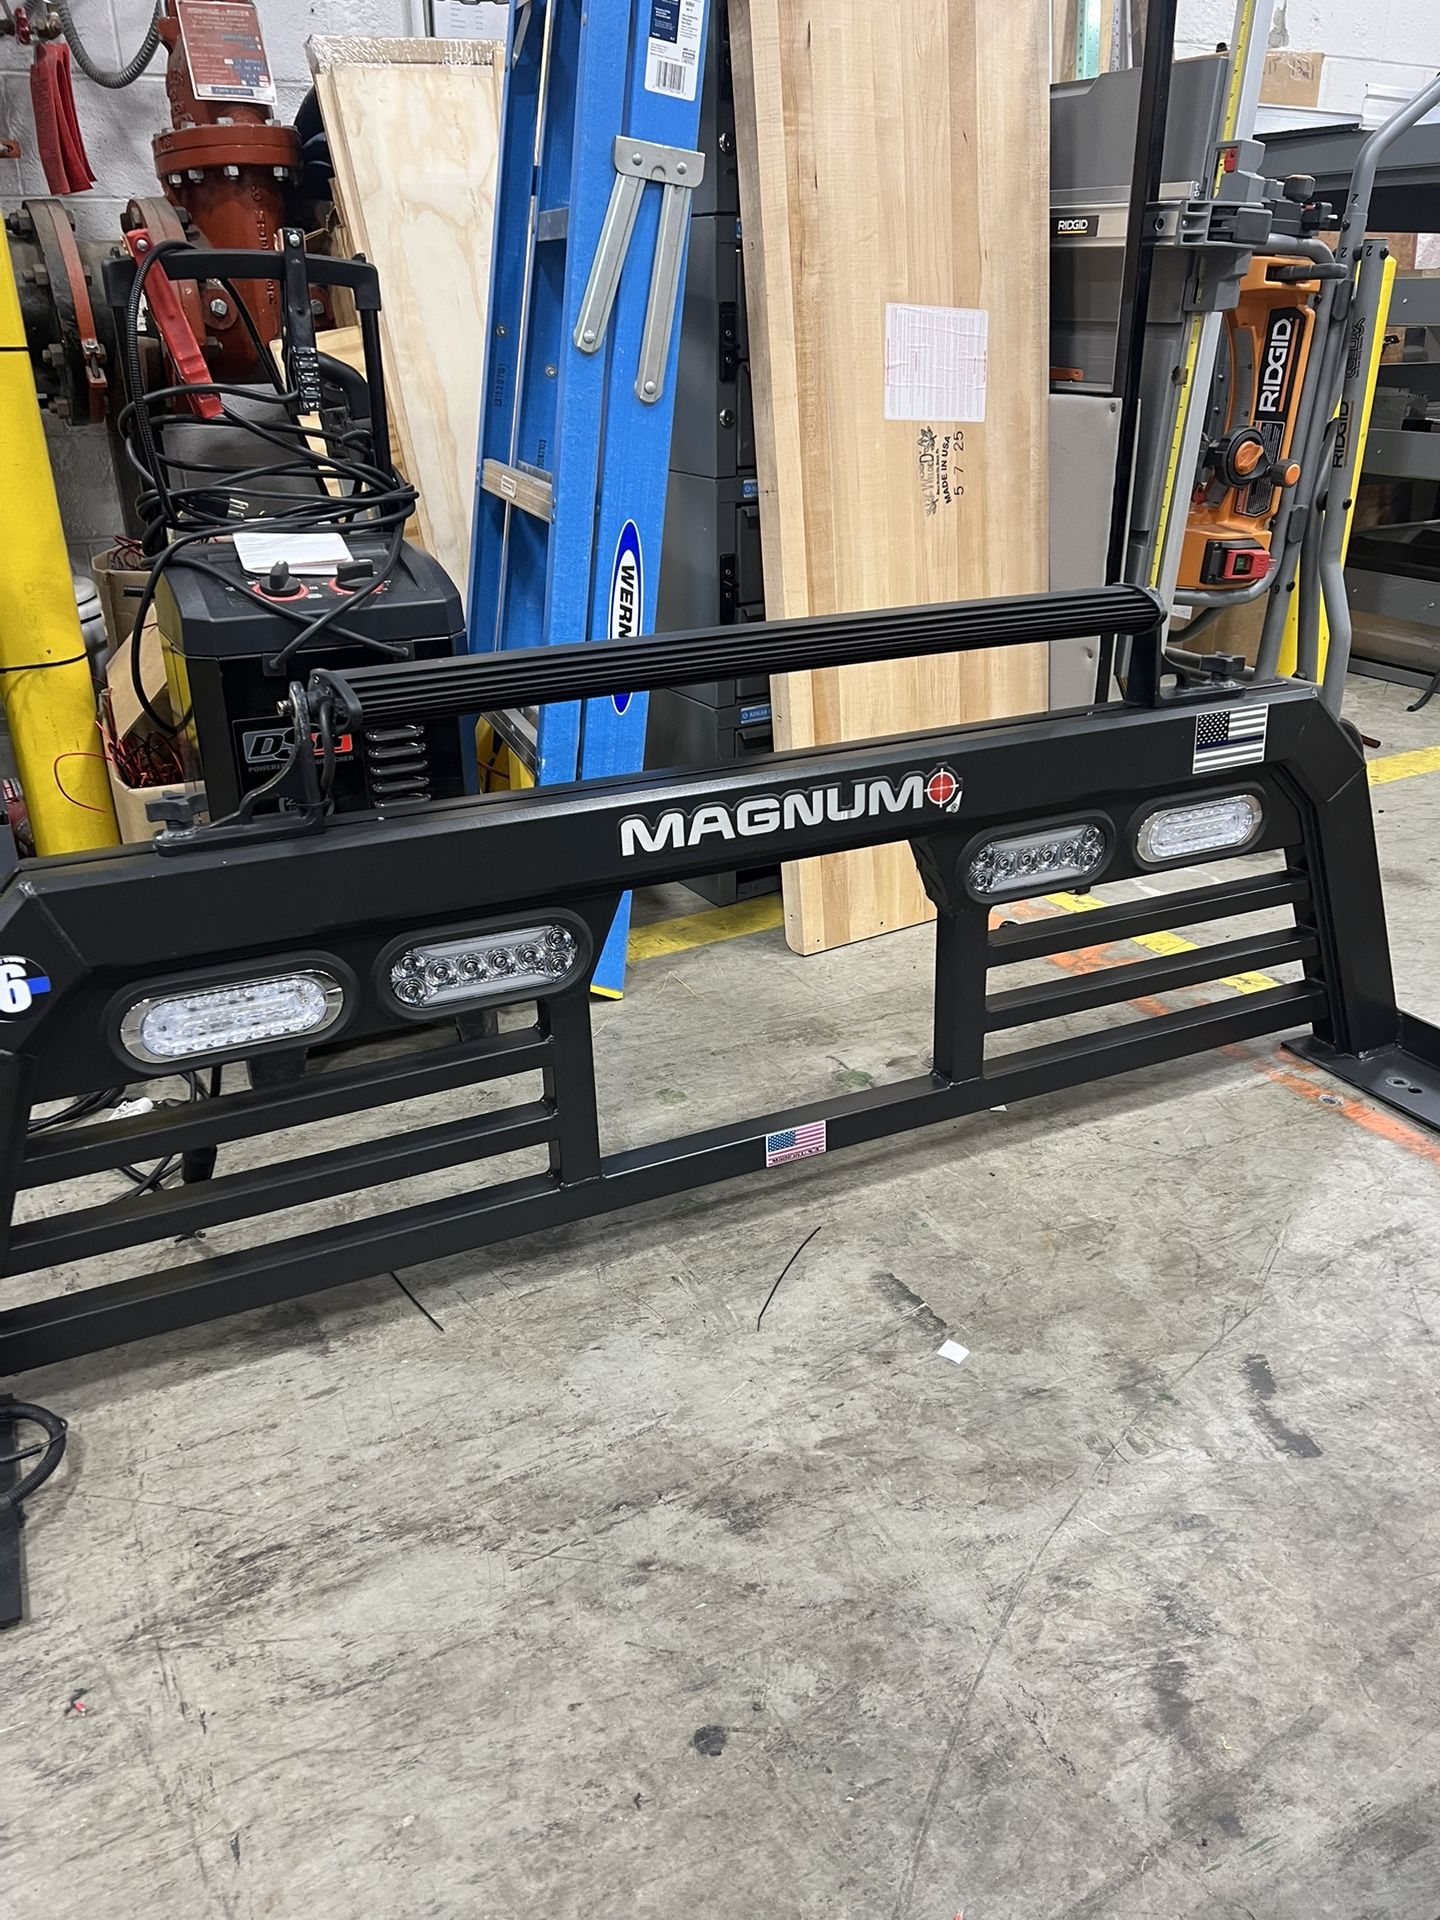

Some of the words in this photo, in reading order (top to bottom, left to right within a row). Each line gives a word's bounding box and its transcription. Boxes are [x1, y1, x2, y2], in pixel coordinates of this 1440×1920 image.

[1058, 219, 1088, 230] RIDGID
[1258, 318, 1292, 412] RIDGID
[953, 430, 965, 452] 25
[1332, 402, 1350, 468] RIDGID
[941, 436, 951, 457] USA
[941, 460, 948, 471] IN
[953, 465, 965, 475] 7
[941, 473, 952, 504] MADE
[953, 485, 965, 496] 5
[619, 565, 635, 638] WERN
[620, 775, 925, 857] MAGNUM
